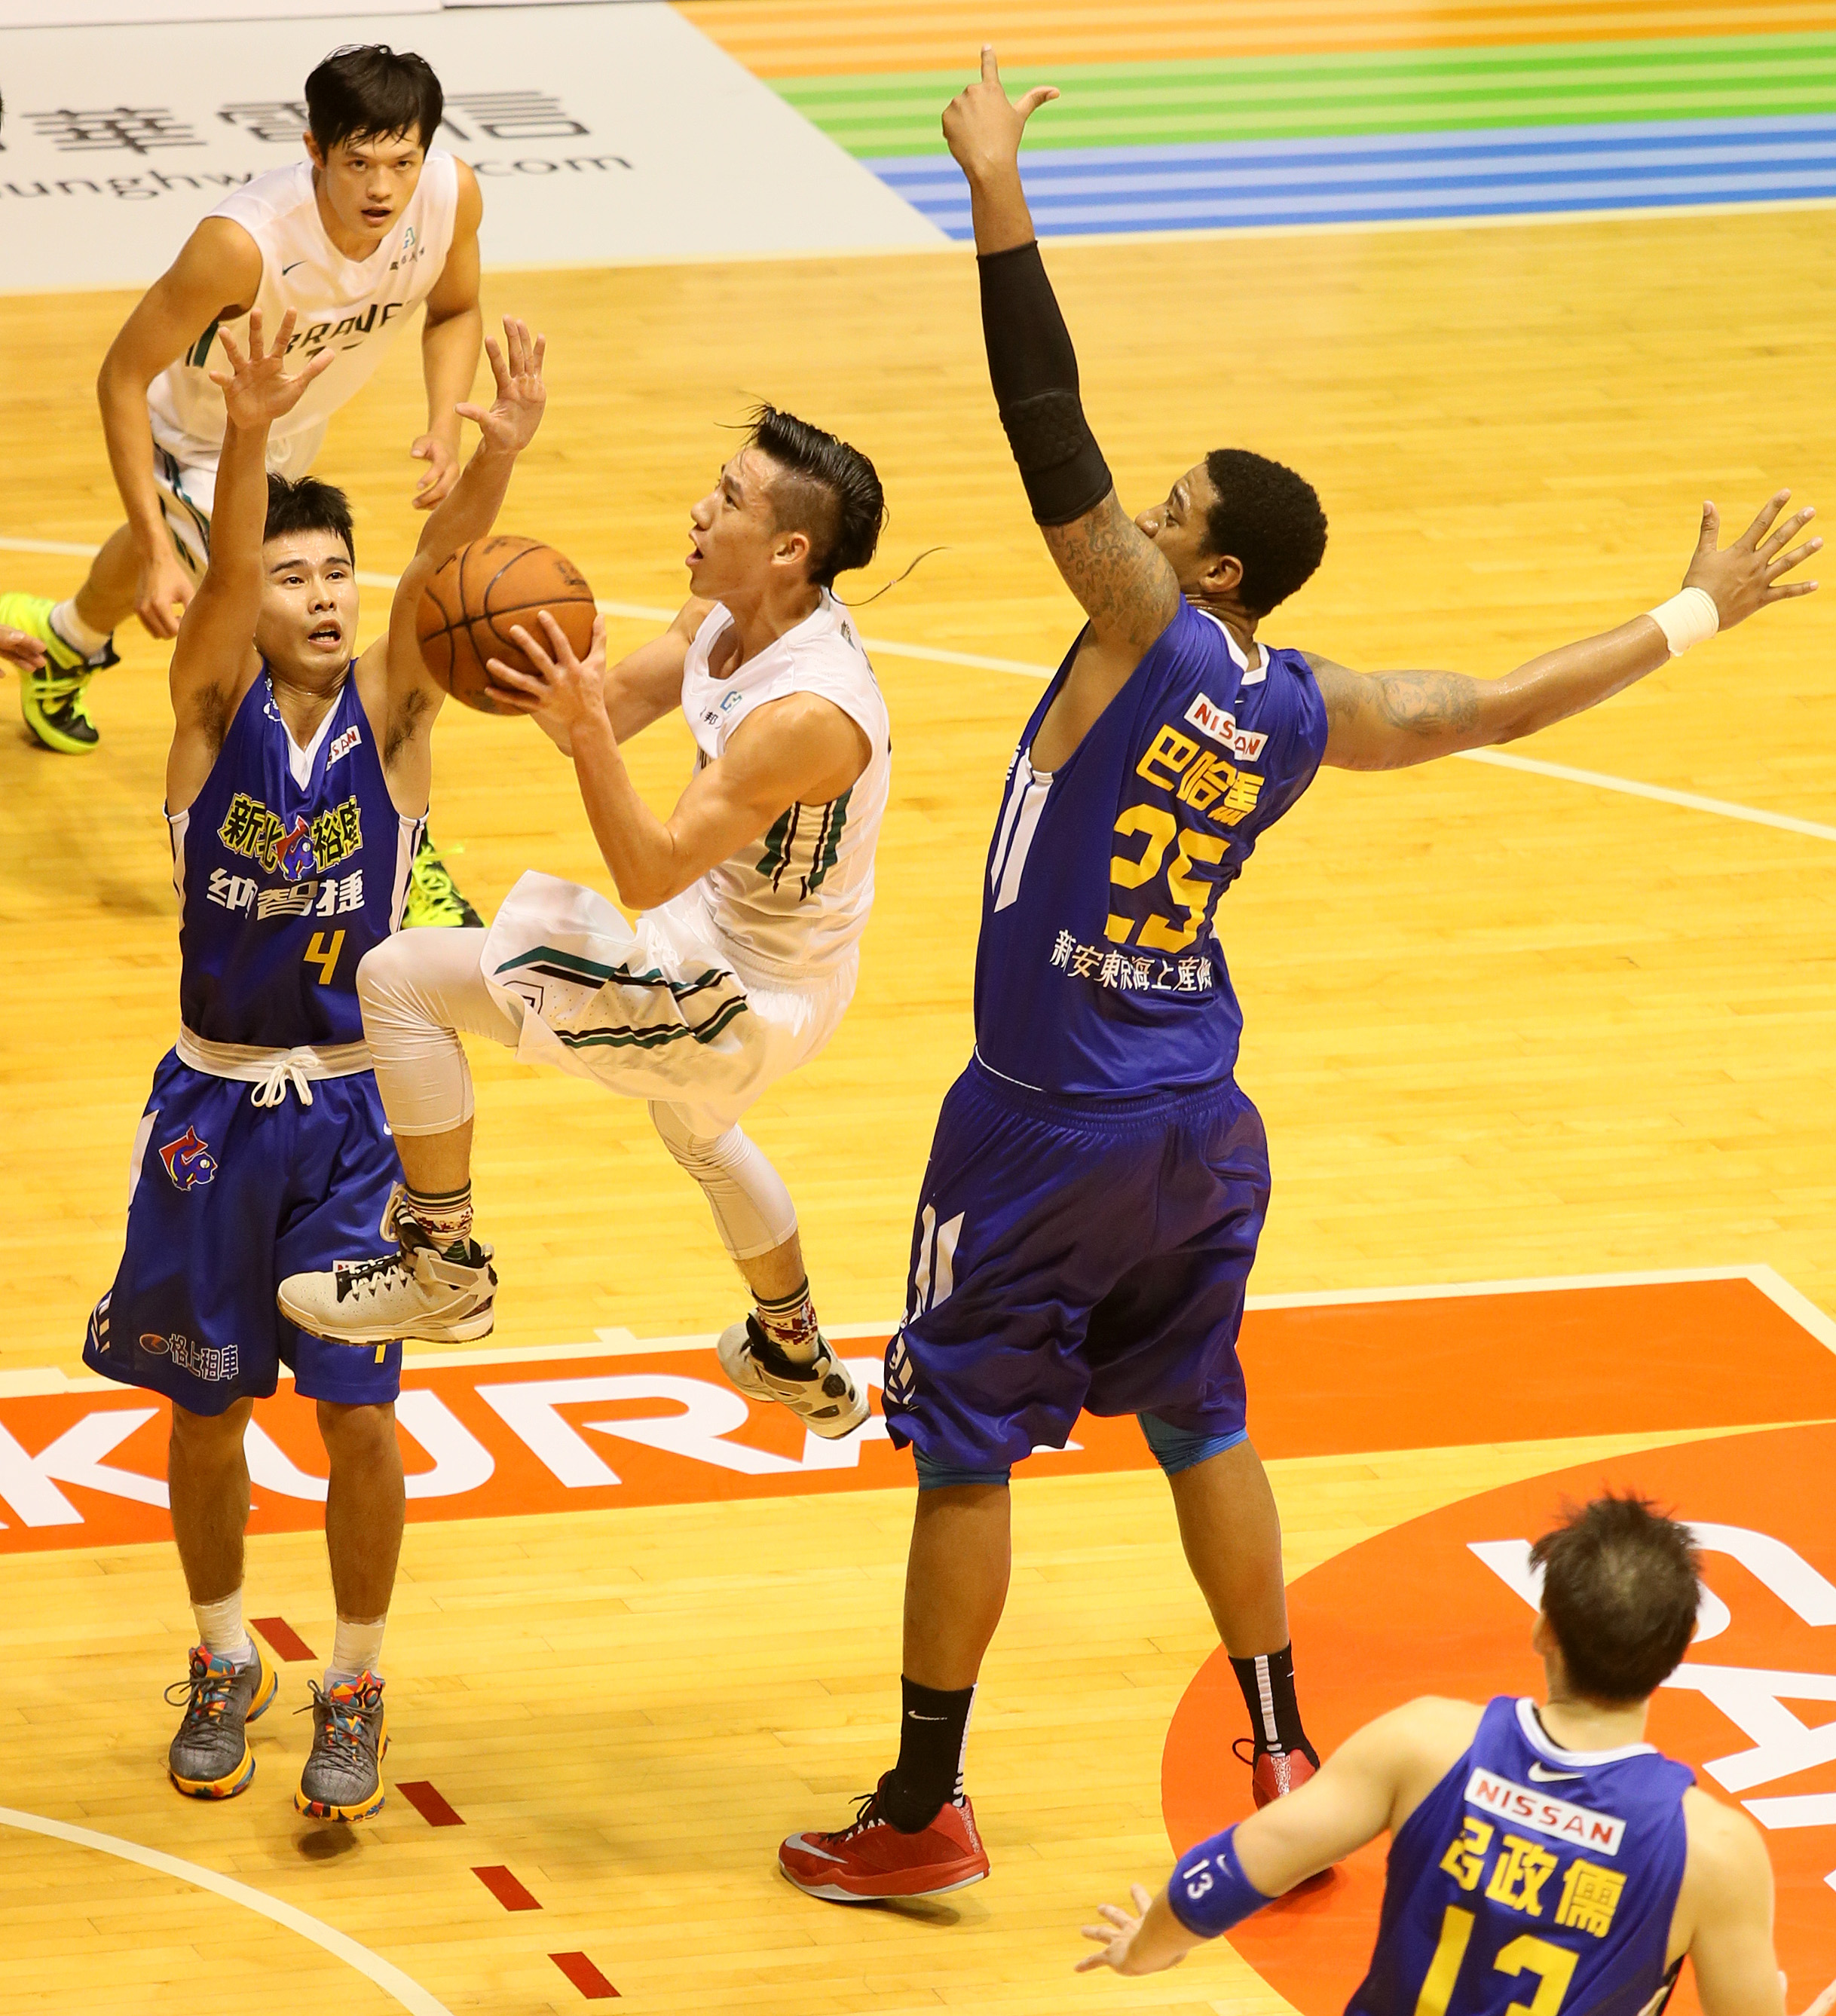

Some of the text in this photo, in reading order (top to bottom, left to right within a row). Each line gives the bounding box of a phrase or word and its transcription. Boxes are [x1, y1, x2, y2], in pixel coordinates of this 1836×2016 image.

[1194, 702, 1260, 755] NISAN
[1103, 803, 1230, 953] 25
[304, 929, 345, 985] 4
[169, 1333, 239, 1381] 格上租車
[1476, 1779, 1614, 1845] NISSAN
[1182, 1858, 1213, 1900] 13
